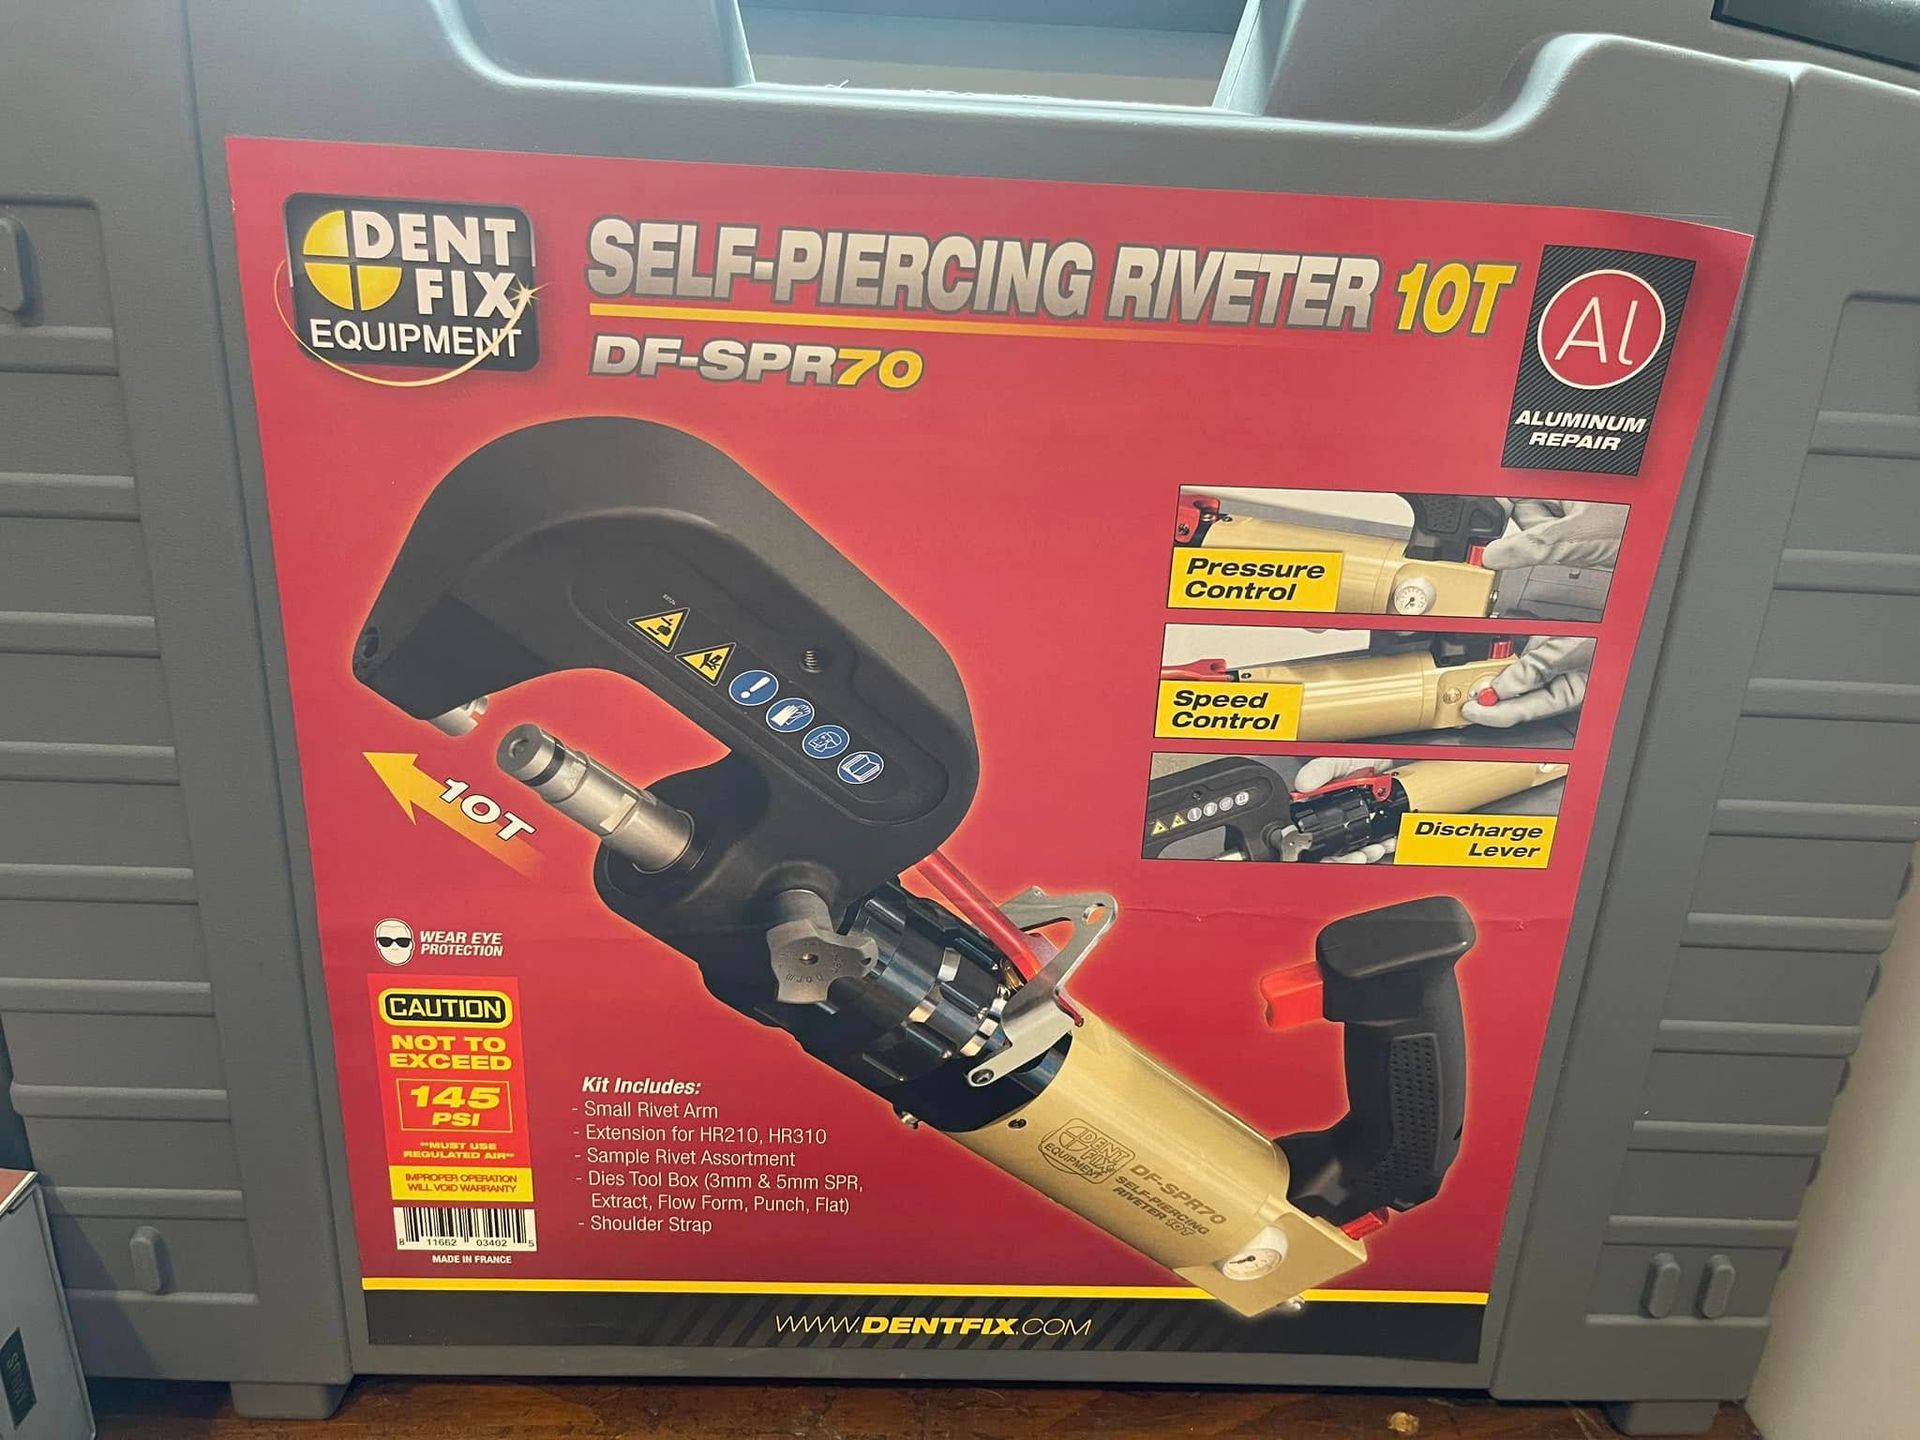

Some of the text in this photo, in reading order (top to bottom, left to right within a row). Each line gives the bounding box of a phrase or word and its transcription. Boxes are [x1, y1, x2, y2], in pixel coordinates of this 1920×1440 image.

[351, 210, 516, 267] DENT
[586, 216, 1517, 336] SELF-PIERCING RIVETER 10T
[415, 268, 520, 320] FIX
[309, 318, 522, 357] EQUIPMENT
[1555, 297, 1638, 365] Al
[591, 335, 923, 389] DF-SPR70
[1515, 410, 1647, 433] ALUMINUM
[1529, 432, 1621, 451] REPAIR
[1186, 557, 1325, 579] Pressure
[1185, 580, 1297, 601] Control
[1173, 690, 1269, 710] Speed
[1172, 711, 1280, 730] Control
[439, 777, 537, 841] 10T
[1414, 821, 1543, 842] Discharge
[1468, 841, 1540, 859] Lever
[420, 931, 503, 945] WEAR EYE
[421, 943, 503, 957] PROTECTION
[389, 997, 502, 1019] CAUTION
[391, 1034, 506, 1053] NOT TO
[389, 1053, 512, 1071] EXCEED
[582, 1076, 701, 1095] Kit Includes:
[410, 1085, 500, 1109] 145
[432, 1112, 480, 1127] PSI
[584, 1100, 718, 1119] Small Rivet Arm
[586, 1124, 826, 1145] Extension for HR210, HR310
[1079, 1127, 1130, 1163] DENT
[403, 1151, 480, 1159] REGULATED
[470, 1142, 497, 1150] USE
[587, 1148, 796, 1166] Sample Rivet Assortment
[1044, 1142, 1103, 1179] EQUIPMENT
[1080, 1149, 1116, 1174] FIX
[405, 1173, 517, 1183] IMPROPER OPERATION
[408, 1183, 517, 1193] WILL VOID WARRANTY
[588, 1171, 863, 1193] Dies Tool Box (3mm & 5mm SPR,
[591, 1193, 849, 1215] Extract, Flow Form, Punch, Flat)
[1113, 1187, 1167, 1221] RIVETER
[1130, 1164, 1227, 1225] DF-SPR70
[1115, 1176, 1210, 1235] SELF-PIERCING
[591, 1216, 712, 1235] Shoulder Strap
[399, 1238, 405, 1246] 8
[476, 1239, 508, 1247] 03402
[432, 1255, 512, 1264] MADE IN FRANCE
[775, 1315, 1093, 1336] WWW.DENTFIX.COM
